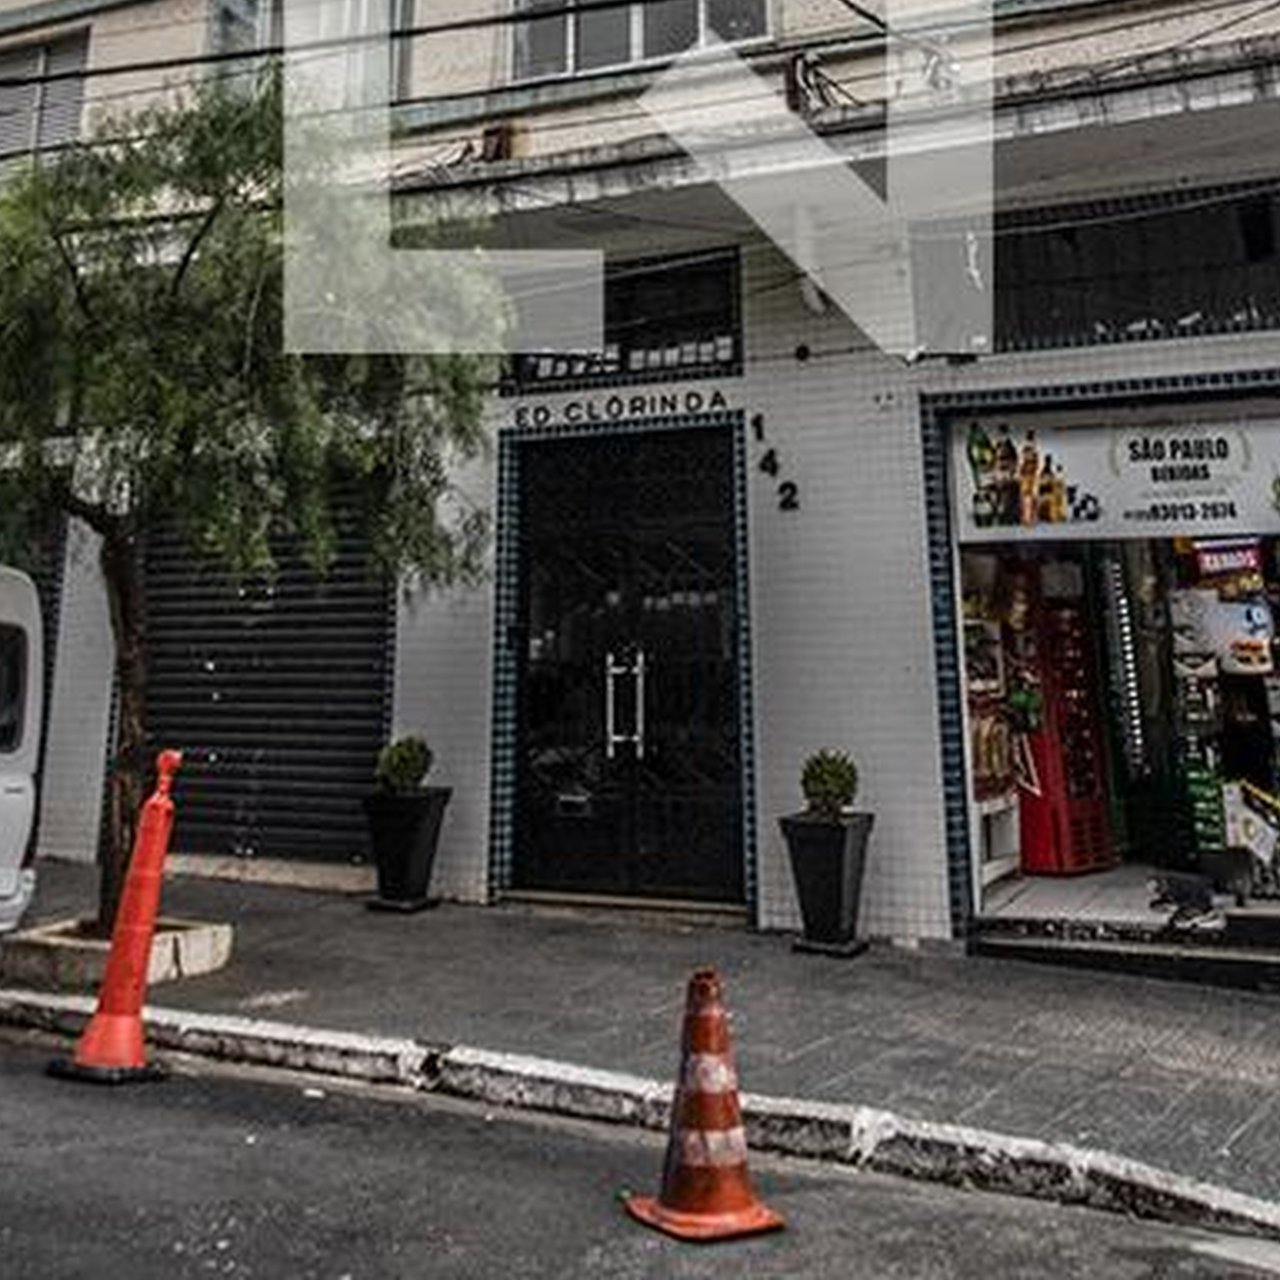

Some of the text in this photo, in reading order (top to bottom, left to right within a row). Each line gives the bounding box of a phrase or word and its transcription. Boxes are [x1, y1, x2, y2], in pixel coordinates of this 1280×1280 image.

[515, 406, 550, 427] ED
[1129, 436, 1228, 461] SÃO PAULO
